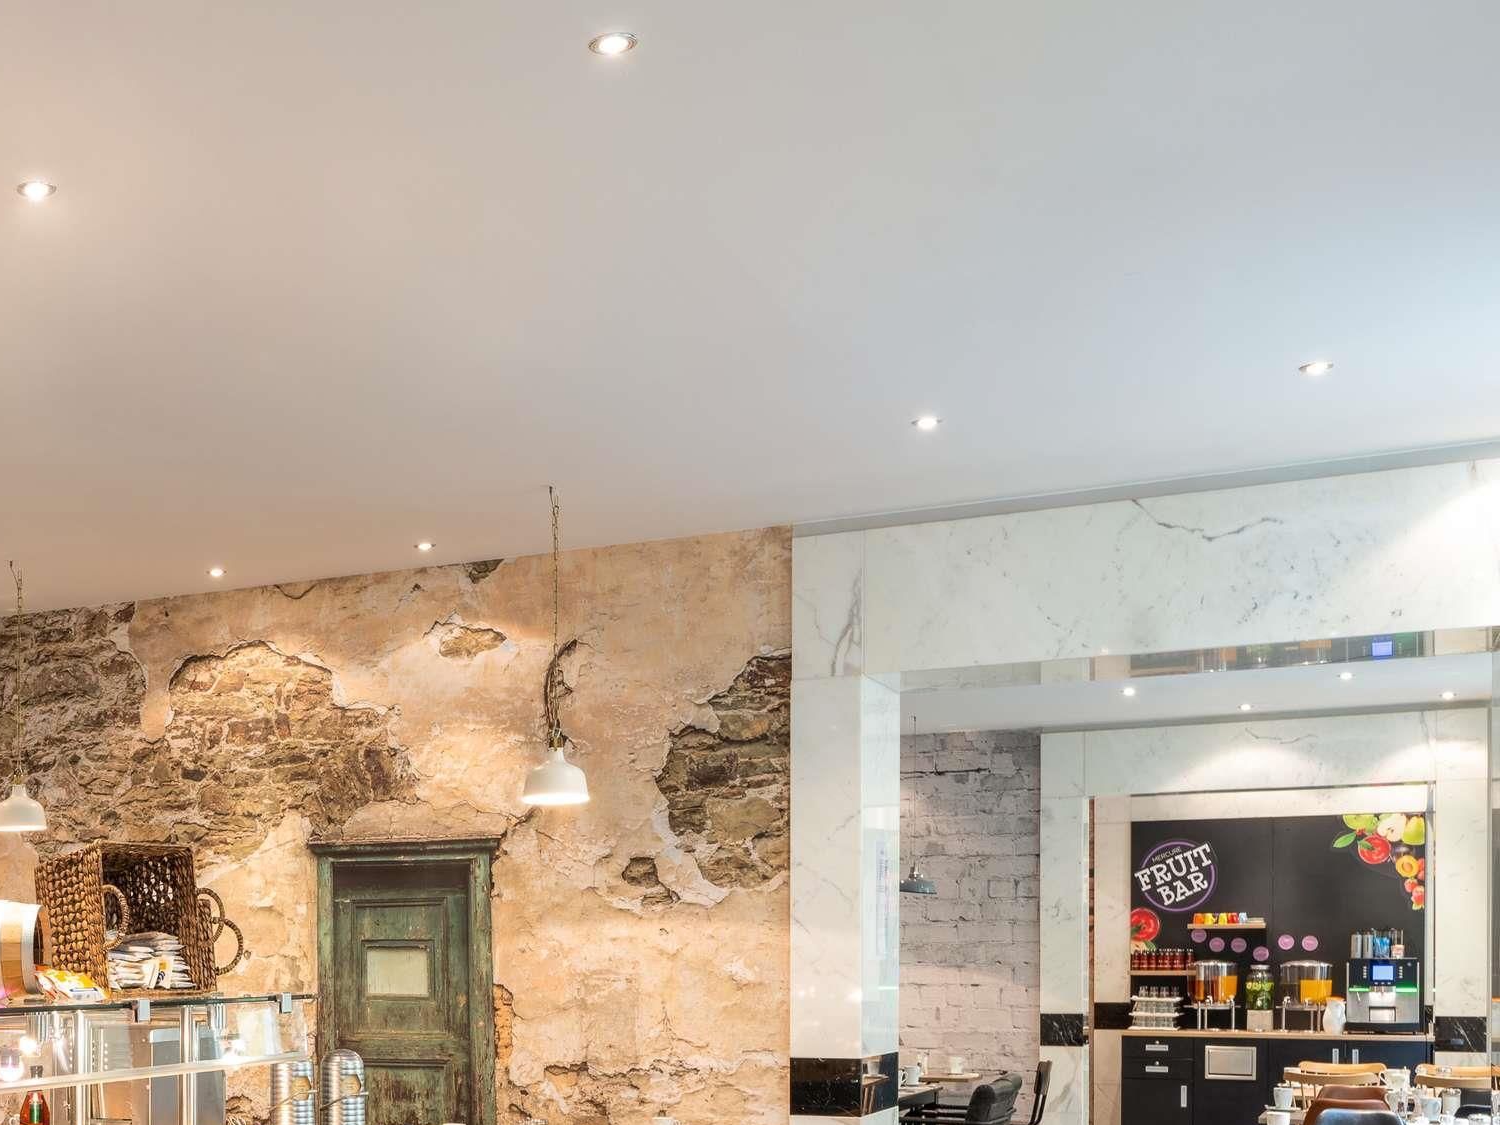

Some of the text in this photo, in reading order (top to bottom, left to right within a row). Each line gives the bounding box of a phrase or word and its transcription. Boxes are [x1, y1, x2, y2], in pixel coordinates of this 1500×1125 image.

[1134, 843, 1212, 891] FRUIT
[1151, 846, 1182, 862] MERCURE
[1156, 872, 1208, 906] BAR
